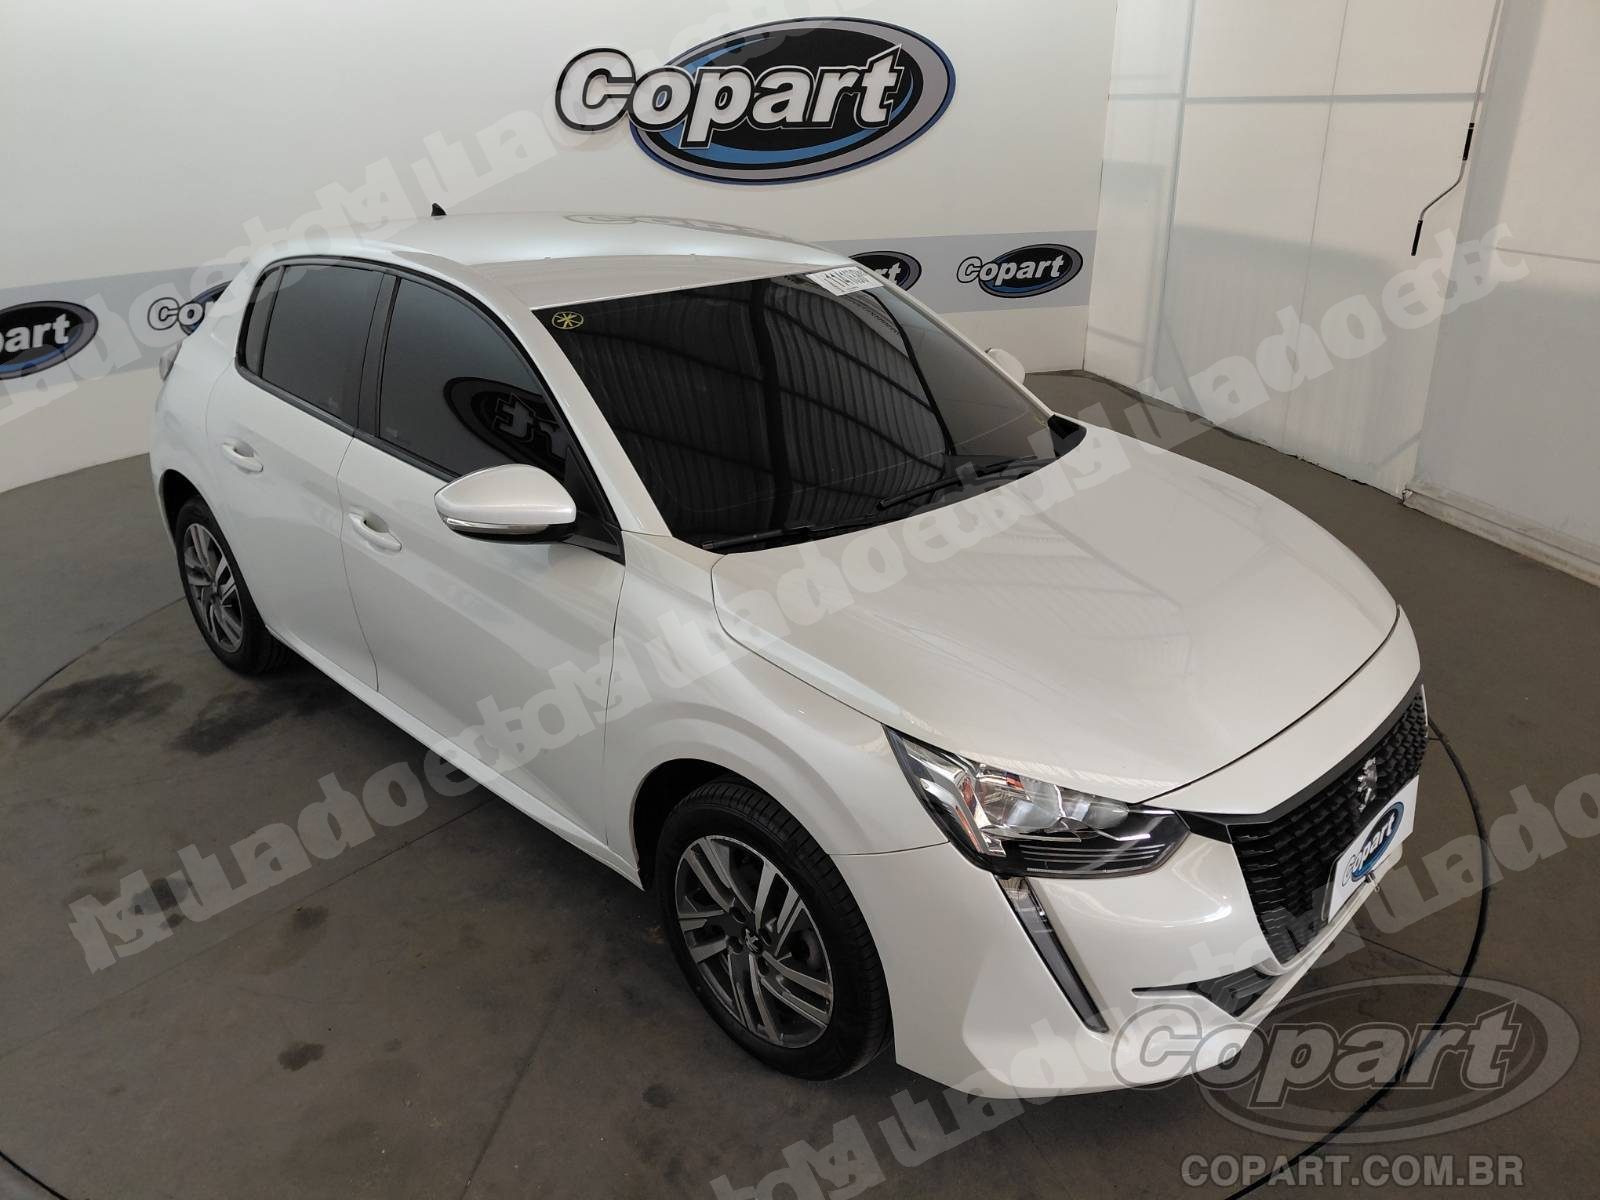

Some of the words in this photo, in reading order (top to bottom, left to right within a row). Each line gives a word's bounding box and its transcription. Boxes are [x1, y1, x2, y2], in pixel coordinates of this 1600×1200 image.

[555, 47, 904, 149] Copart
[957, 256, 1064, 286] Copart
[0, 313, 70, 353] art
[1341, 811, 1396, 887] Copart
